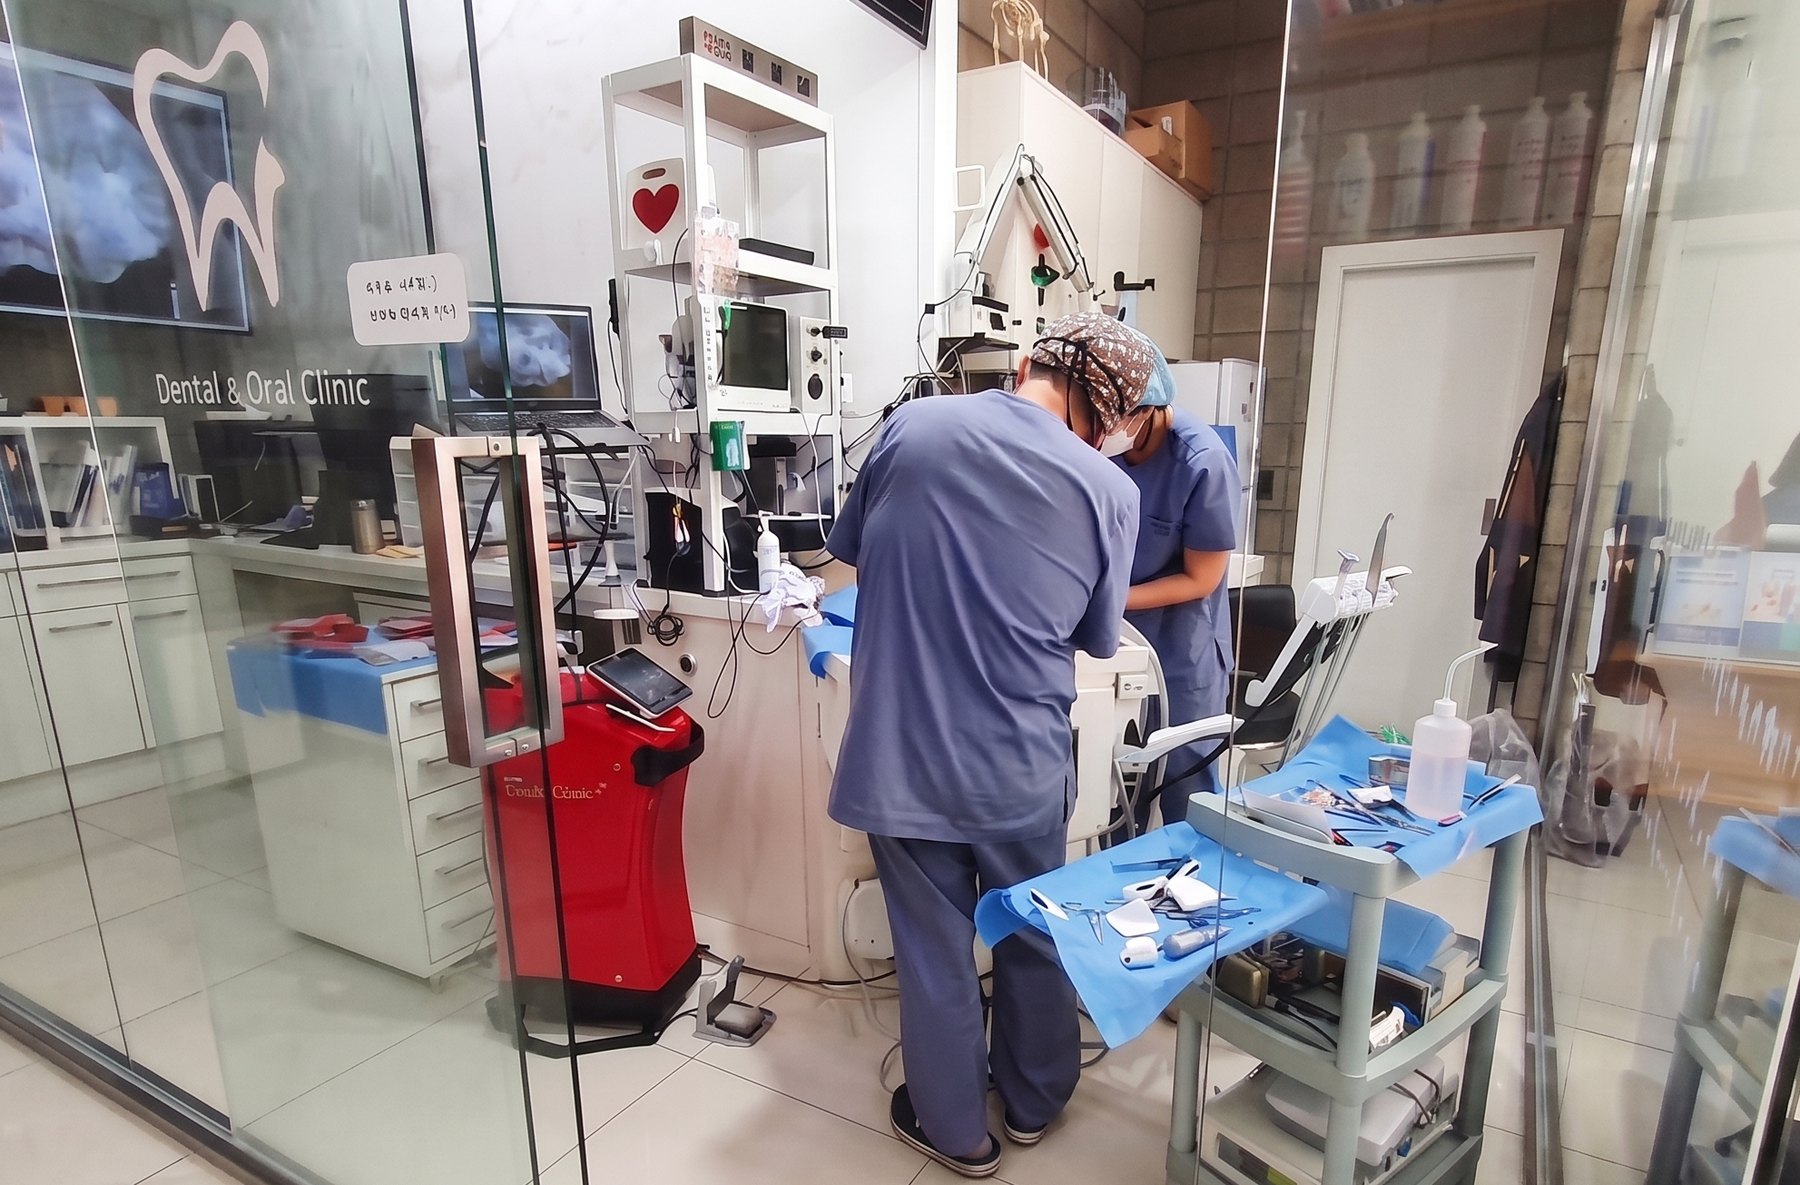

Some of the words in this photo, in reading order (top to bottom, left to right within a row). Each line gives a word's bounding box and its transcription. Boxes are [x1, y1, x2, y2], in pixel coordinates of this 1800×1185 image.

[155, 370, 222, 405] Dental
[227, 376, 241, 405] &
[246, 369, 296, 405] Oral
[301, 368, 371, 406] Clinic
